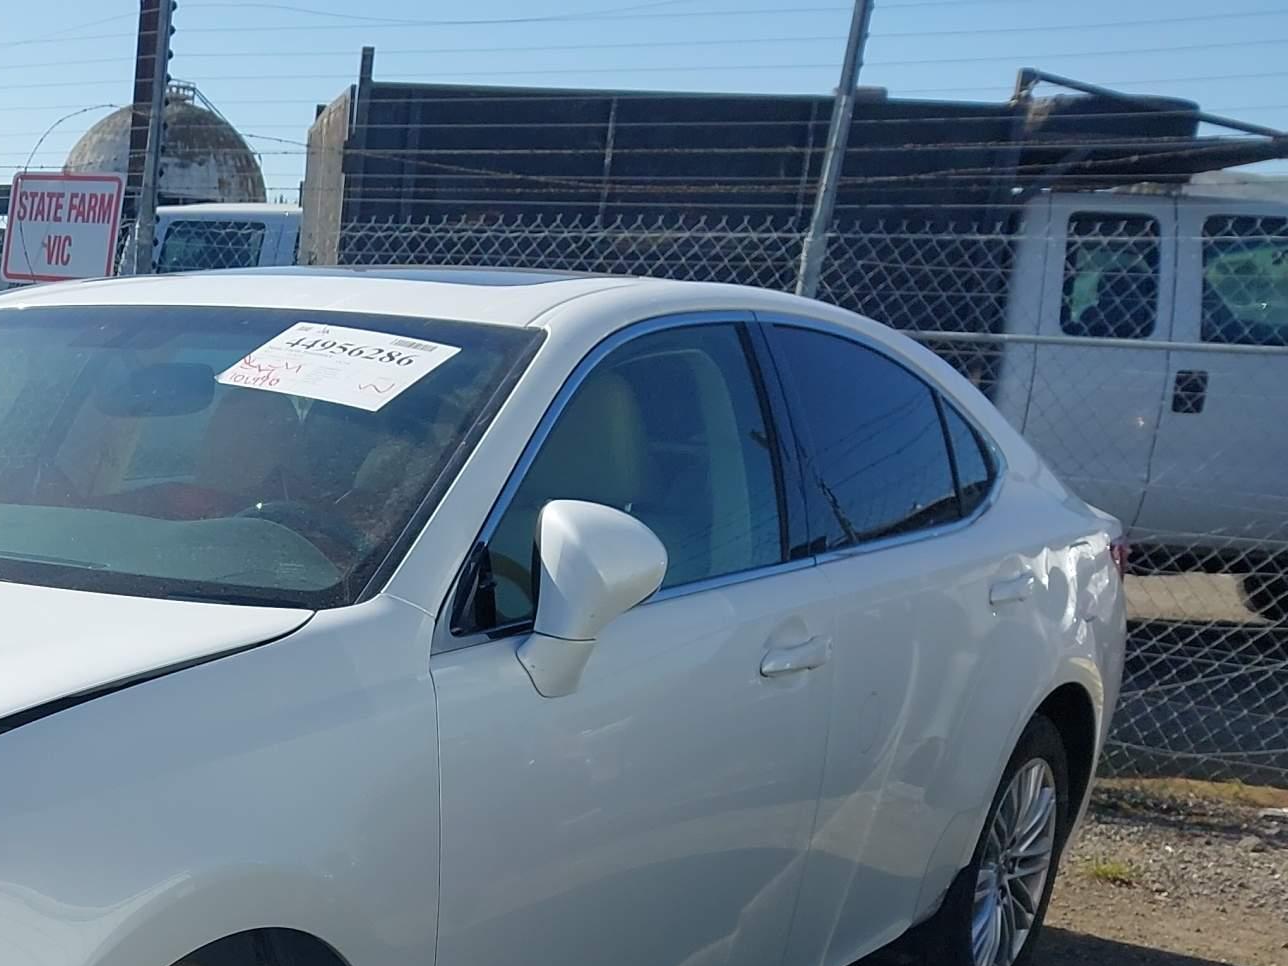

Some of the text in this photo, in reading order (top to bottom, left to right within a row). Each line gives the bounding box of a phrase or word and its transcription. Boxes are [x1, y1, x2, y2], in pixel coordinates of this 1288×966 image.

[17, 191, 114, 224] STATE FARM
[45, 235, 72, 266] VIC
[286, 336, 418, 366] 44956286
